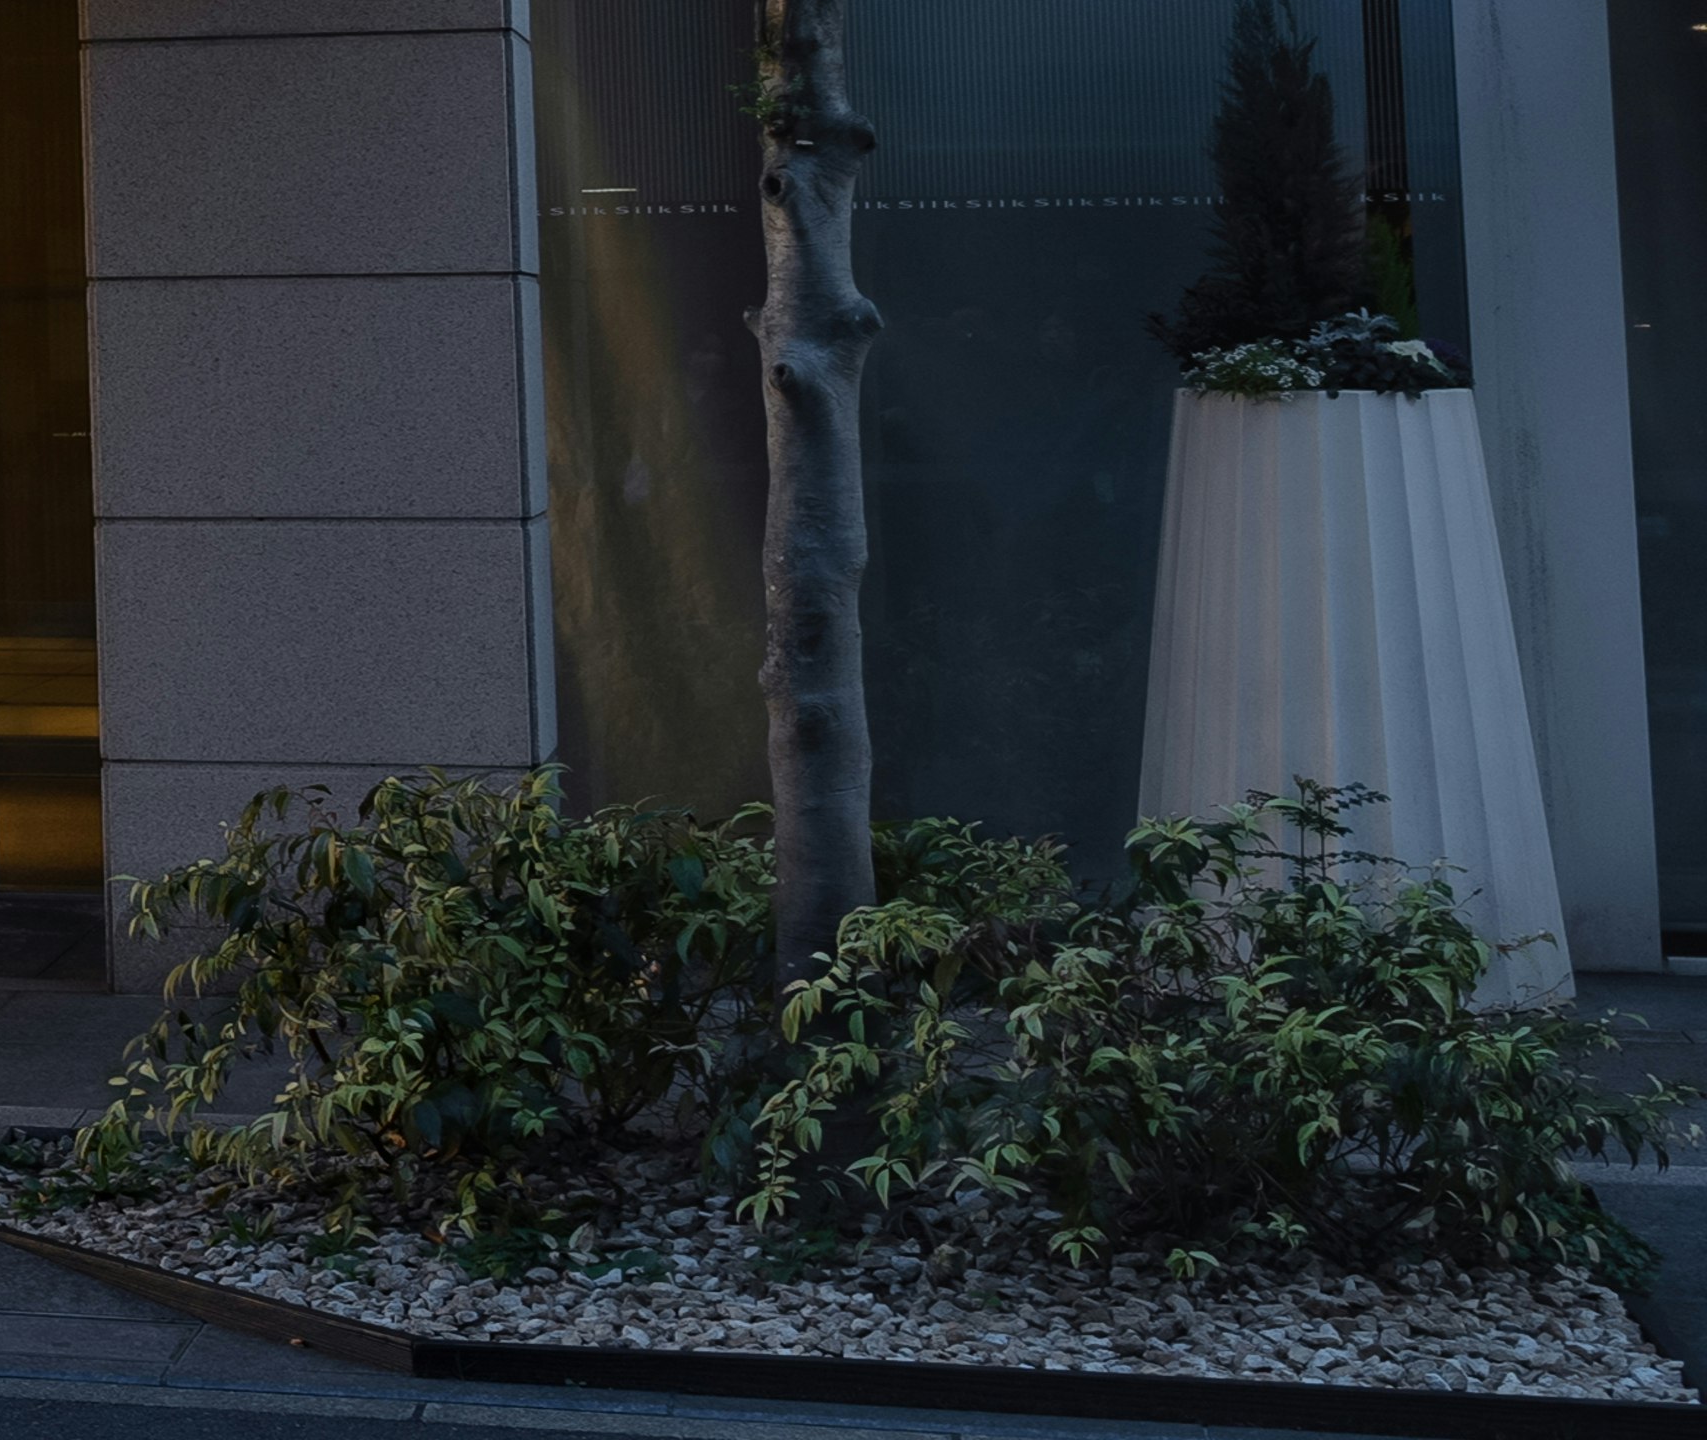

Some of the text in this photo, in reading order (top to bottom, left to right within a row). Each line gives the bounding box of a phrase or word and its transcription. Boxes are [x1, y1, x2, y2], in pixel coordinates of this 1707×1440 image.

[852, 200, 891, 210] ilk
[898, 200, 958, 210] Silk
[965, 199, 1026, 209] Silk
[1034, 197, 1095, 207] Silk
[1102, 196, 1163, 206] Silk
[1382, 192, 1446, 202] Silk
[549, 207, 607, 216] Silk
[614, 205, 672, 215] Silk
[679, 204, 738, 214] Silk
